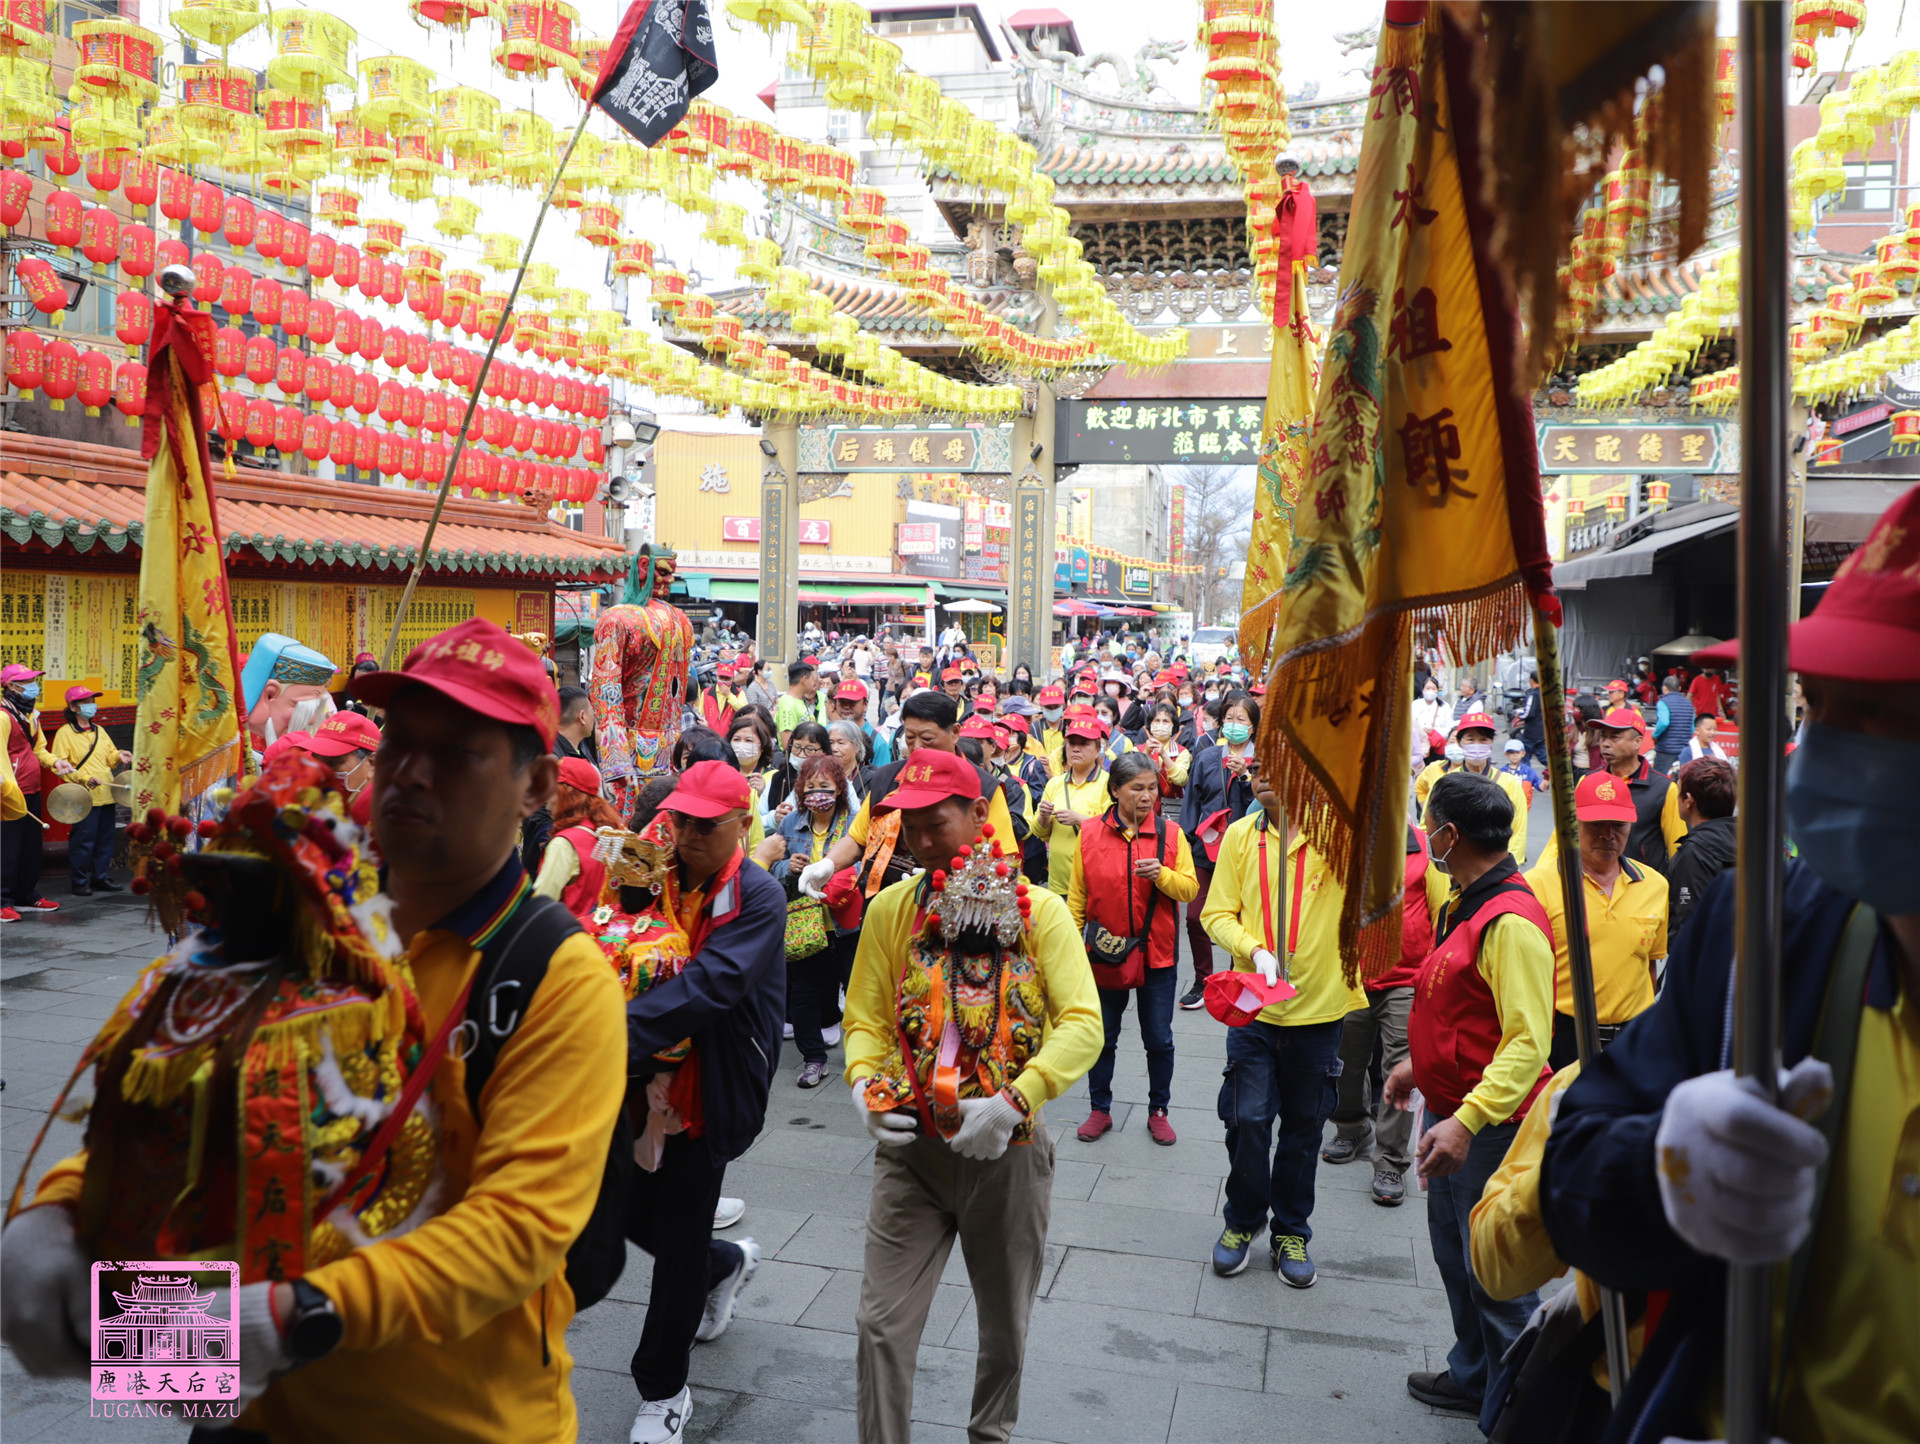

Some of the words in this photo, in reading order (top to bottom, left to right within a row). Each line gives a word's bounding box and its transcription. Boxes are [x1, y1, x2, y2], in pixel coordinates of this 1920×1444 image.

[1085, 405, 1261, 430] 歡迎新北市貢寮
[699, 462, 731, 493] 施
